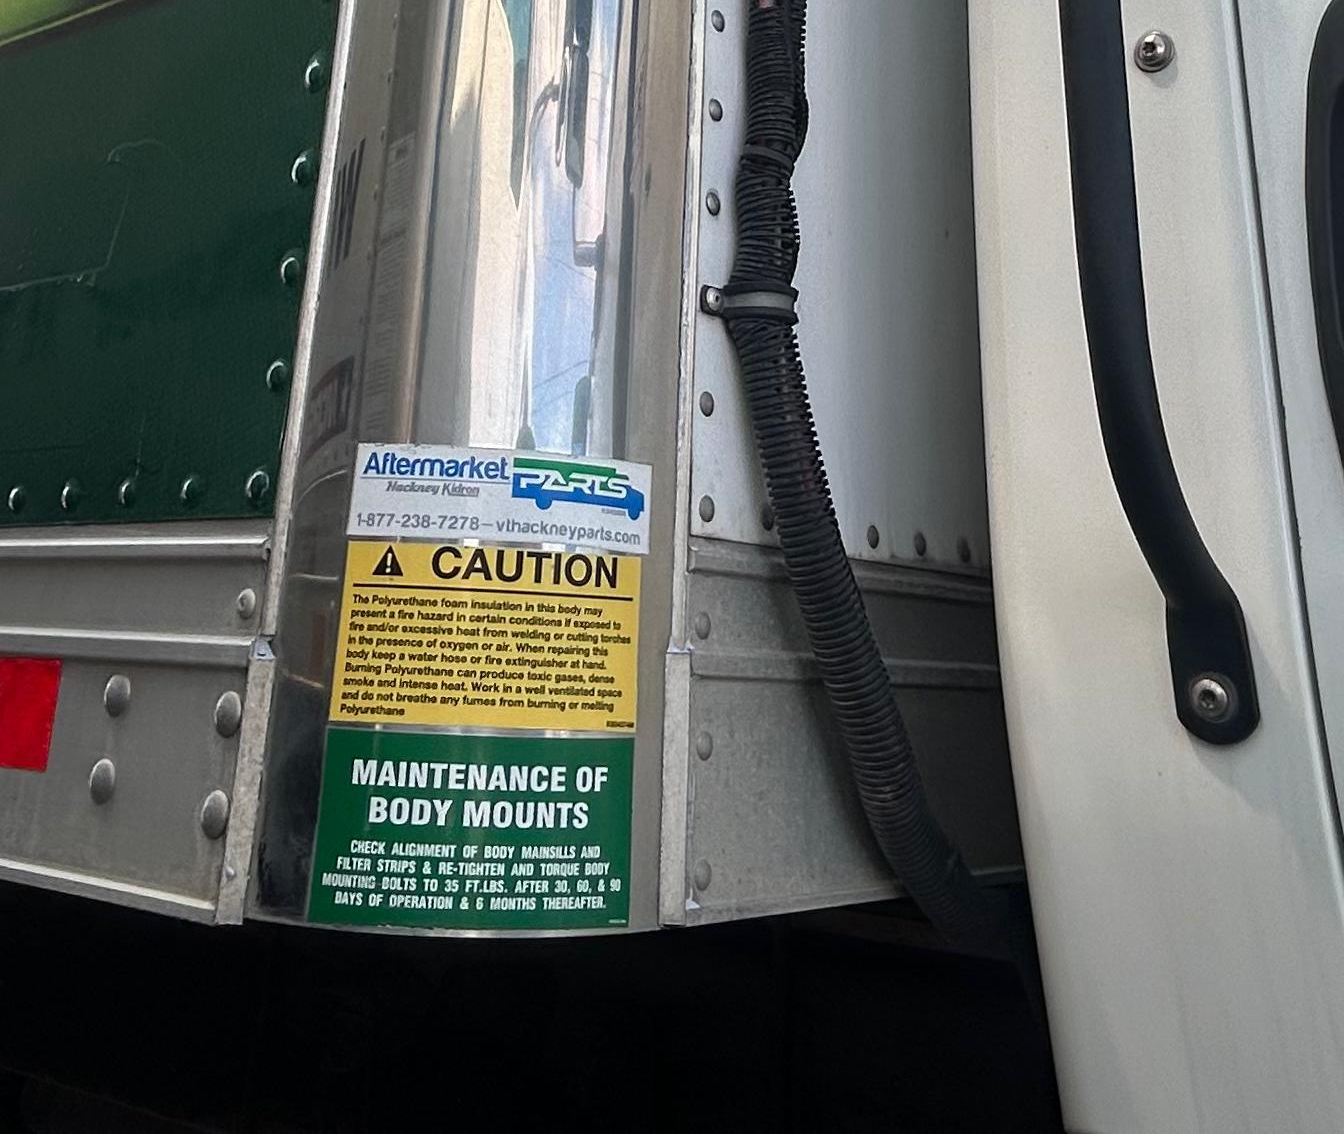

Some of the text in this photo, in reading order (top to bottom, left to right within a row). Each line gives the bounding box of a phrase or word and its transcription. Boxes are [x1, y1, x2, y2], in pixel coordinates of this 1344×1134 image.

[363, 452, 628, 499] Aftermarket PARTS
[386, 481, 480, 497] Hackney Kidron
[432, 546, 617, 588] CAUTION
[353, 594, 603, 617] The Polyurethane foam insulation in this body may
[350, 609, 387, 620] present
[398, 610, 414, 619] fire
[417, 610, 453, 621] hazard
[457, 612, 465, 622] in
[469, 614, 506, 624] certain
[509, 615, 562, 627] conditions
[564, 618, 572, 626] if
[573, 620, 611, 630] exposed
[613, 621, 621, 630] to
[349, 621, 364, 632] fire
[367, 623, 398, 633] and/or
[401, 625, 453, 635] excessive
[456, 626, 480, 636] heat
[483, 627, 508, 637] from
[511, 629, 551, 641] welding
[567, 633, 598, 644] cutting
[358, 635, 374, 645] the
[376, 637, 423, 647] presence
[426, 638, 437, 647] of
[439, 641, 478, 651] oxygen
[496, 642, 512, 652] air.
[516, 643, 544, 653] When
[548, 646, 590, 657] repairing
[592, 646, 608, 656] this
[346, 649, 370, 660] body
[372, 650, 396, 661] keep
[408, 653, 438, 661] water
[441, 654, 467, 663] hose
[485, 655, 502, 665] fire
[505, 657, 568, 668] extinguisher
[570, 659, 580, 668] at
[345, 662, 381, 675] Burning
[385, 664, 453, 677] Polyurethane
[457, 670, 476, 678] can
[480, 669, 524, 680] produce
[528, 671, 552, 681] toxic
[589, 674, 614, 683] dense
[343, 677, 374, 686] smoke
[377, 678, 396, 687] and
[399, 678, 438, 689] intense
[441, 681, 468, 691] heat.
[471, 682, 500, 692] Work
[503, 683, 512, 693] in
[525, 685, 545, 695] well
[548, 686, 595, 696] ventilated
[597, 689, 622, 698] space
[340, 704, 405, 715] Polyurethane
[341, 690, 359, 699] and
[361, 691, 373, 700] do
[376, 693, 393, 701] not
[396, 692, 436, 703] breathe
[440, 696, 460, 706] any
[463, 695, 495, 706] fumes
[499, 697, 524, 707] from
[527, 698, 566, 711] burning
[581, 701, 614, 712] melting
[352, 759, 608, 792] MAINTENANCE OF
[368, 796, 589, 828] BODY MOUNTS
[351, 840, 386, 855] CHECK
[391, 842, 456, 858] ALIGNMENT
[463, 845, 478, 858] OF
[484, 845, 515, 859] BODY
[581, 845, 601, 859] AND
[336, 856, 610, 877] FILTER STRIPS & RE-TIGHTEN AND TORQUE BODY
[322, 872, 376, 888] MOUNTING
[381, 876, 417, 891] BOLTS
[423, 879, 438, 892] TO
[444, 880, 459, 892] 35
[514, 880, 549, 893] AFTER
[597, 878, 605, 892] &
[610, 878, 621, 892] 90
[334, 890, 606, 910] DAYS OF OPERATION & 6 MONTHS THEREAFTER.
